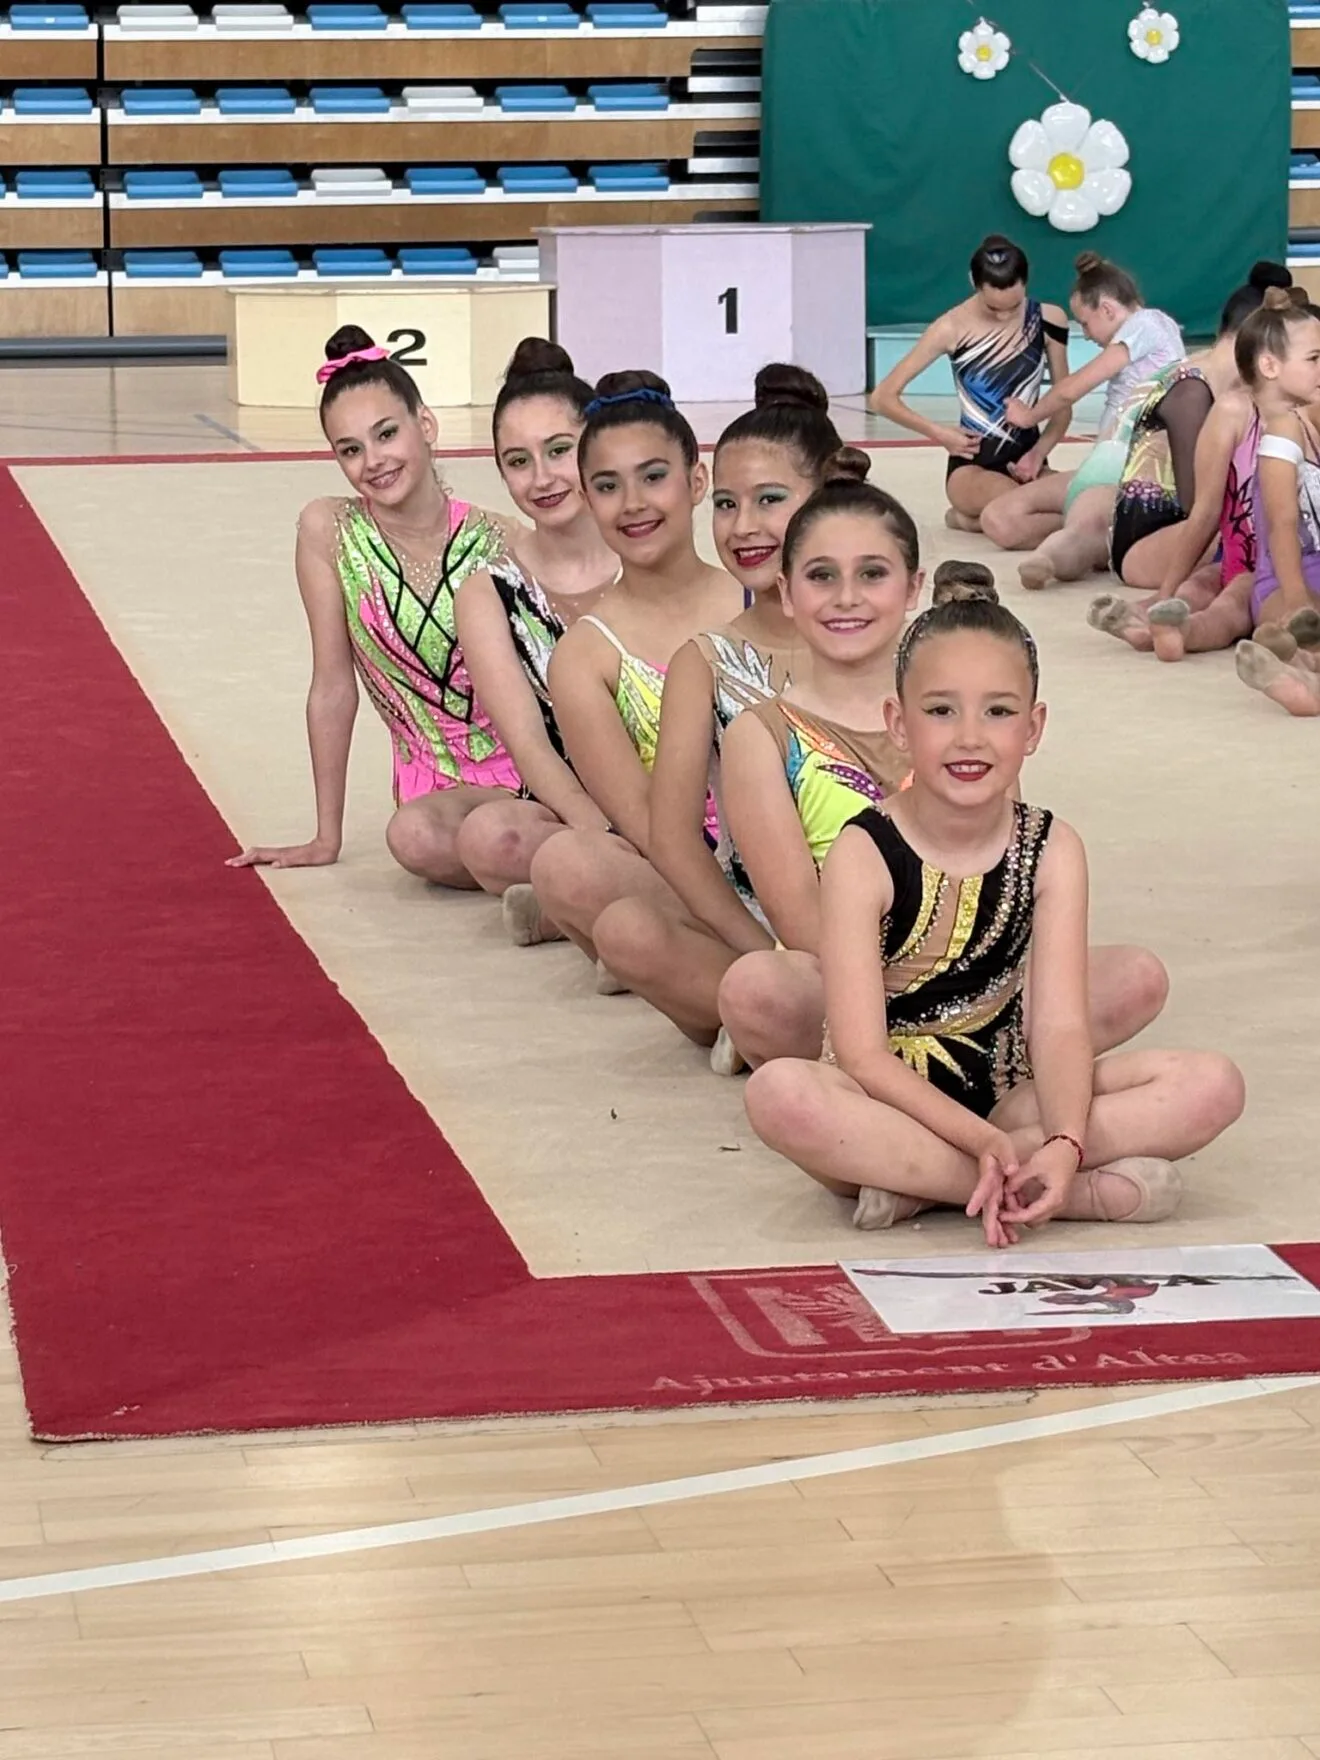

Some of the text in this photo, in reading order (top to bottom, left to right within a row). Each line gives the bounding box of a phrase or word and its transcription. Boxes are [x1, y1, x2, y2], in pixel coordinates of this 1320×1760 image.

[717, 287, 738, 334] 1
[386, 329, 427, 366] 2
[978, 1274, 1221, 1295] JAVA
[648, 1363, 1010, 1396] Ajuntament
